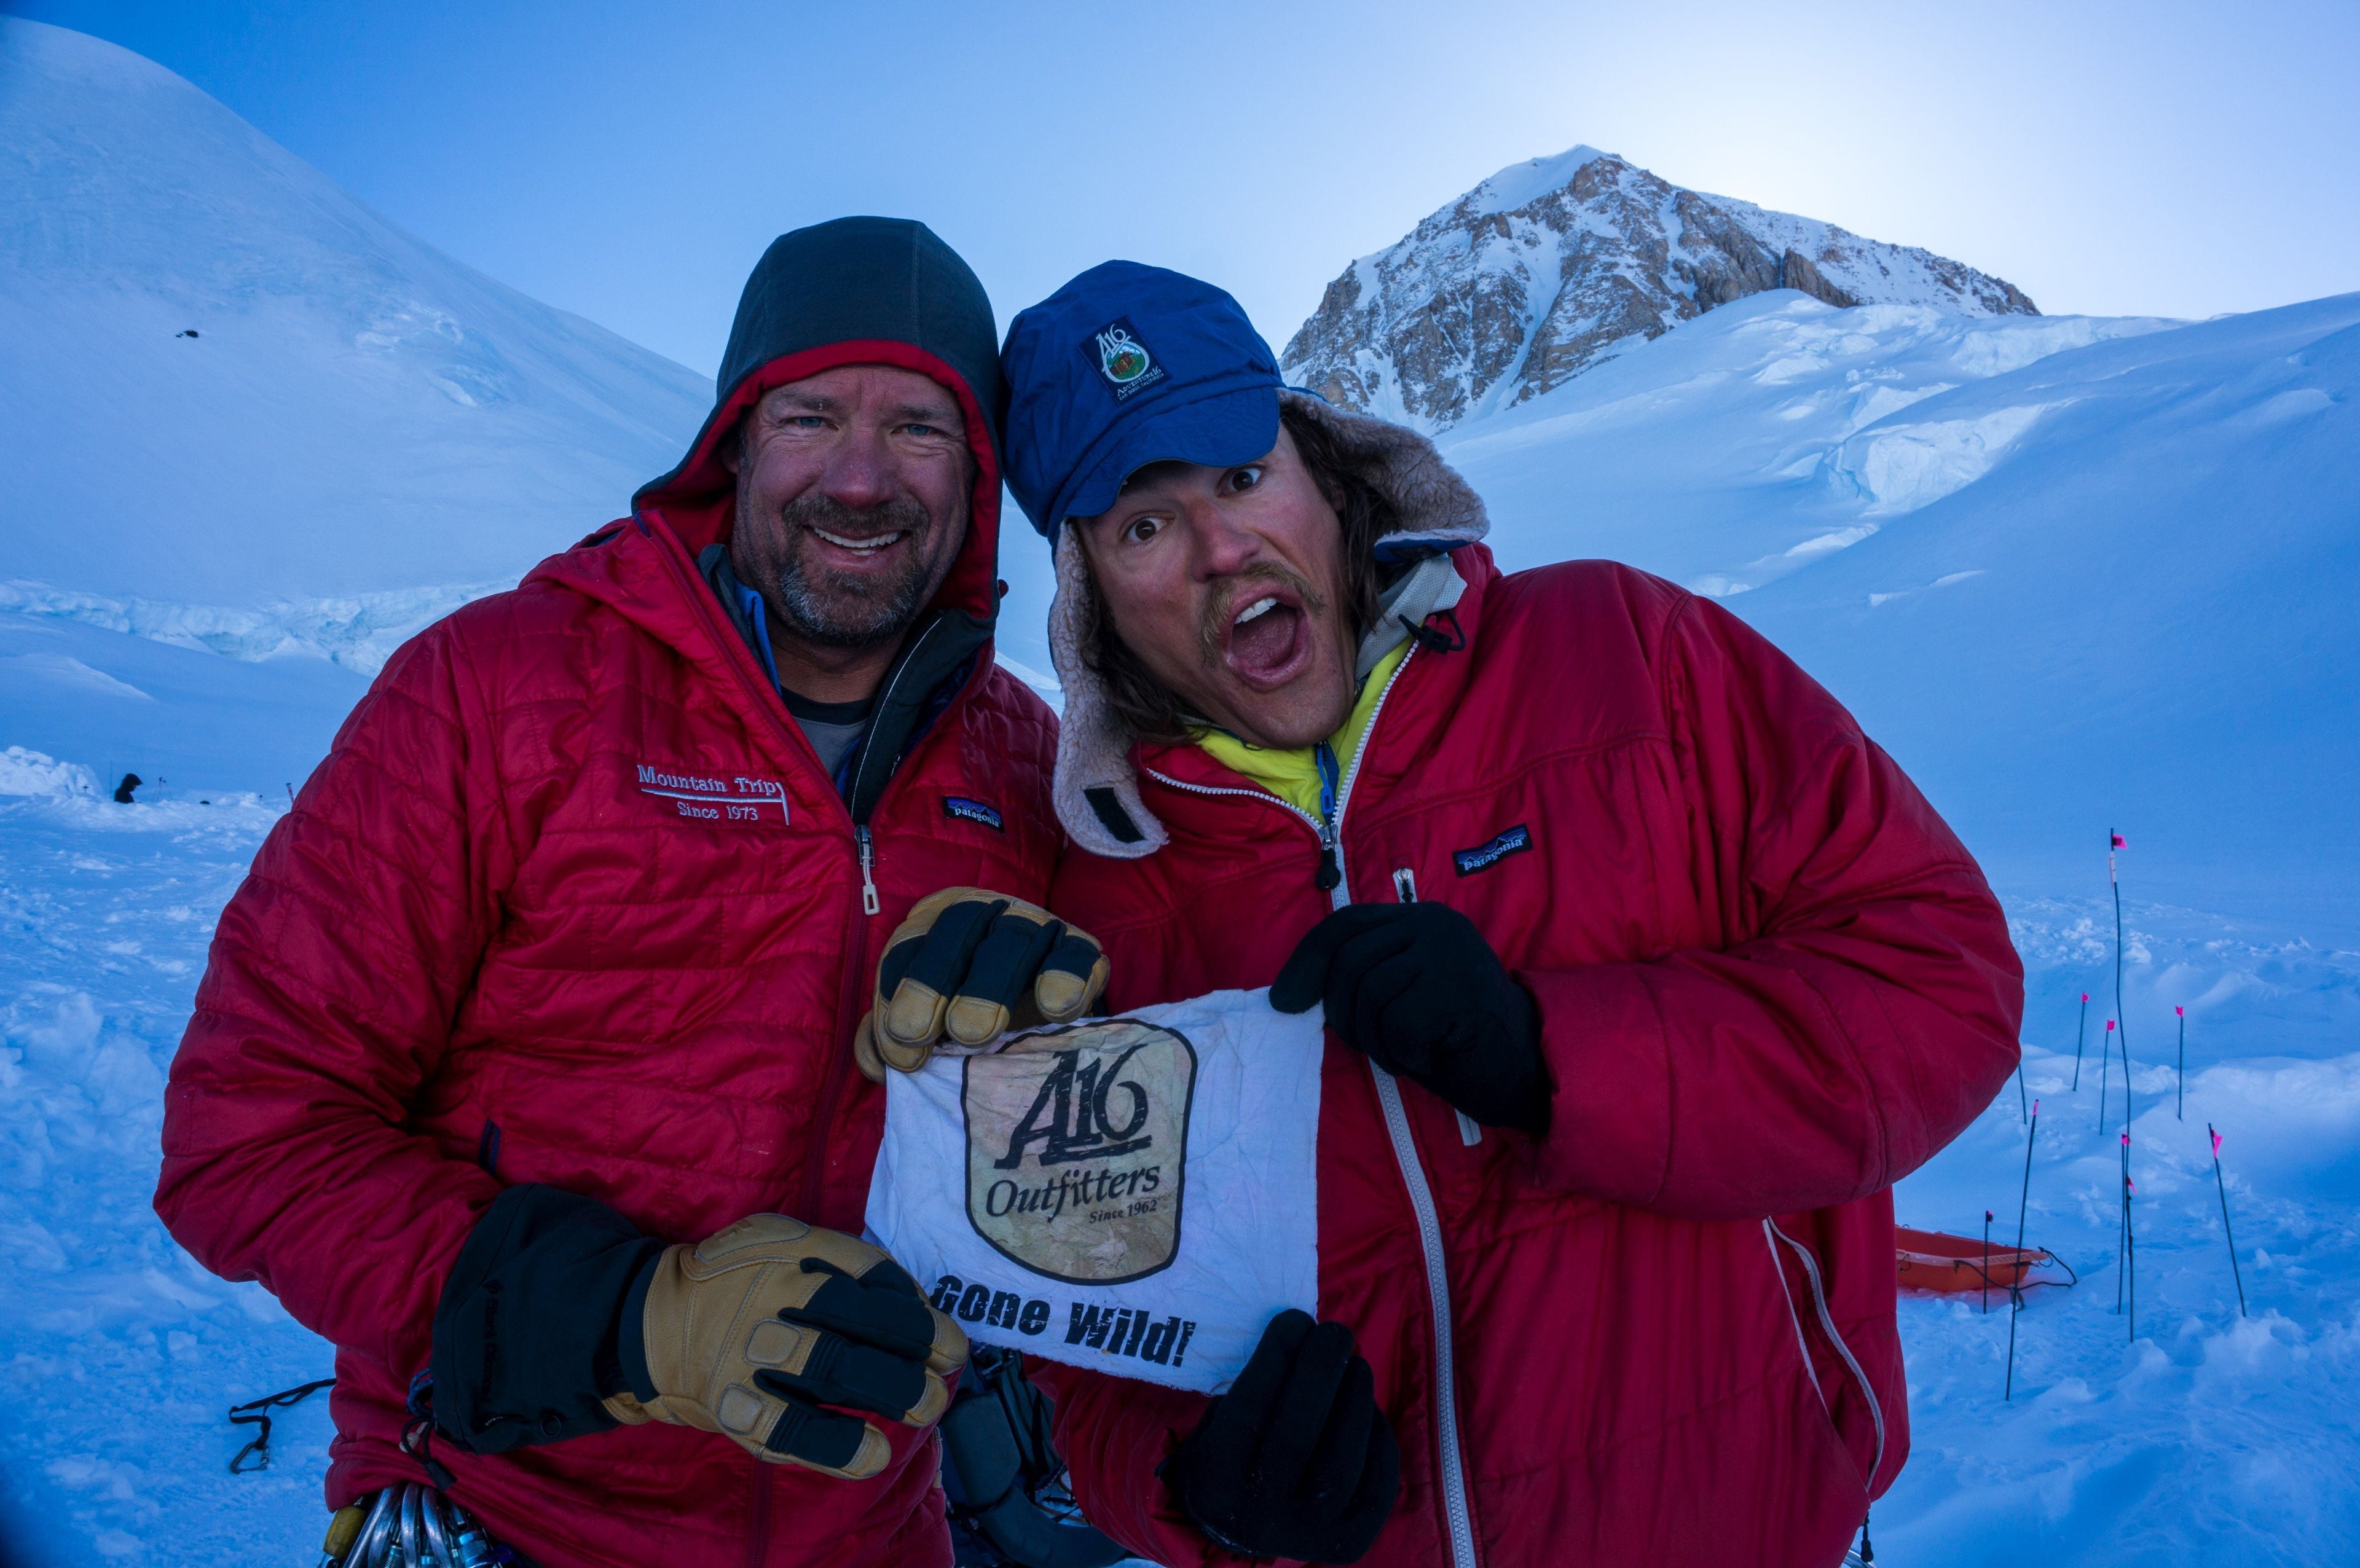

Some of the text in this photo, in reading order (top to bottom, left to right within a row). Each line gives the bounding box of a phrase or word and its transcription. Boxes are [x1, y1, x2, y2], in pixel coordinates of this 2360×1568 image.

[1095, 323, 1131, 373] A16
[637, 764, 777, 796] Mountain Trip
[677, 801, 759, 821] Since 1973
[954, 807, 999, 828] patagonia
[1463, 838, 1524, 871] patagonia
[993, 1043, 1152, 1169] A16
[985, 1166, 1160, 1223] Outfitters
[1089, 1199, 1157, 1224] Since 1962
[929, 1274, 1197, 1368] Gone Wild!
